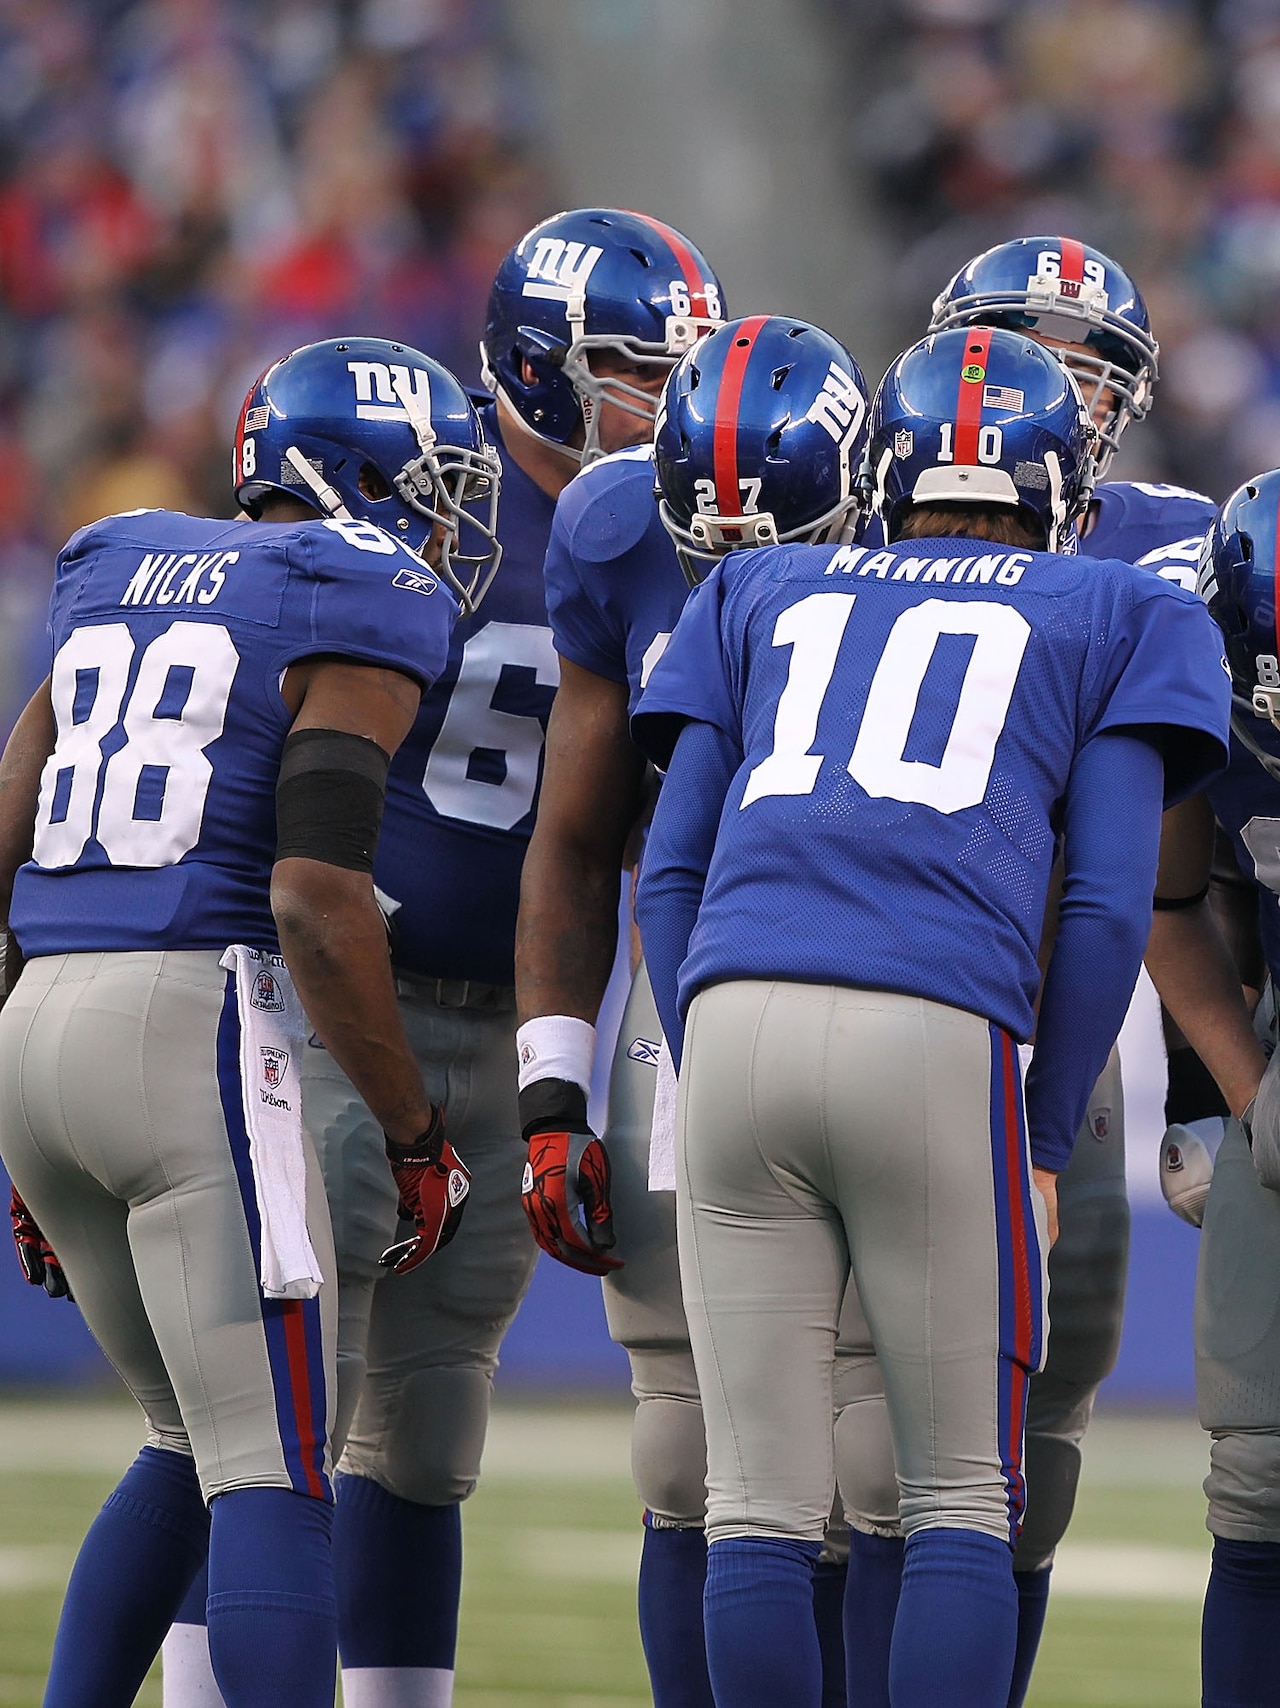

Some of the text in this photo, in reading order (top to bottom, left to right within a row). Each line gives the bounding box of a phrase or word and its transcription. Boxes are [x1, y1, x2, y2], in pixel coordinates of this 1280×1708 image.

[1037, 251, 1106, 289] 69
[937, 423, 1003, 464] 10
[694, 478, 762, 515] 27
[120, 551, 240, 607] NICKS
[825, 545, 1033, 587] MANNING
[740, 592, 1032, 815] 10
[32, 621, 240, 869] 88
[260, 1089, 291, 1111] Wilson
